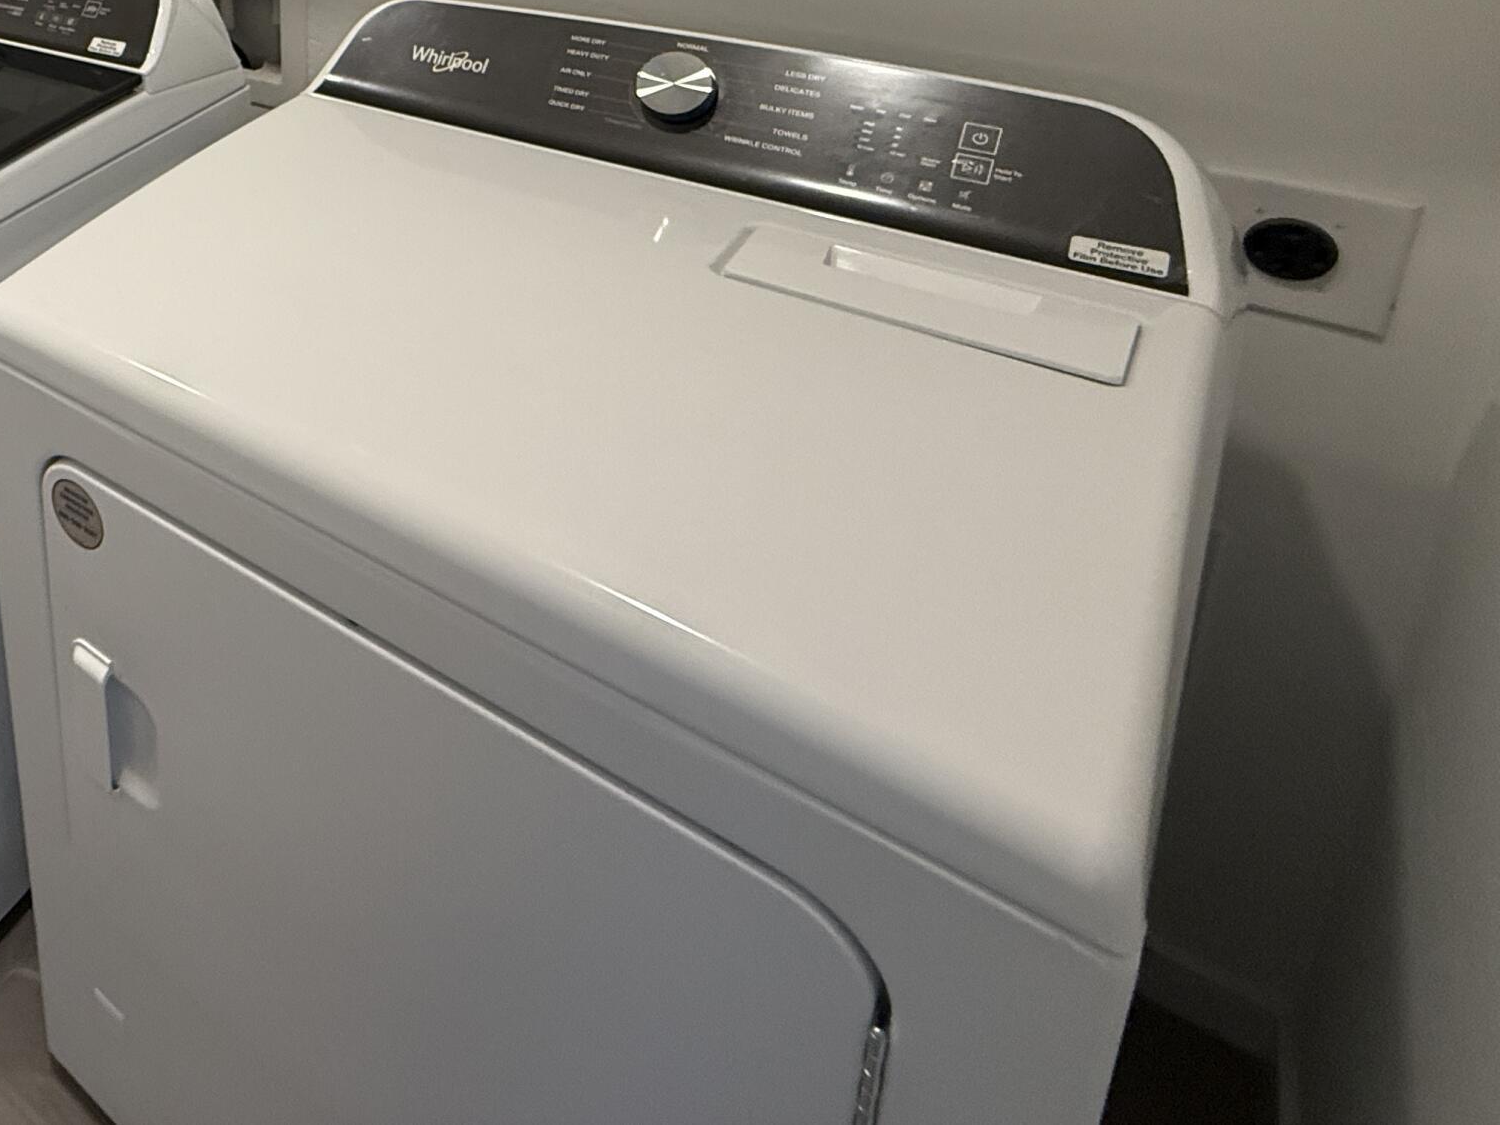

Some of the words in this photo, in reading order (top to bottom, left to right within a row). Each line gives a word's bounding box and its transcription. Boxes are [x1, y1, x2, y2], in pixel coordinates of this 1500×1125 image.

[570, 34, 589, 44] MORE
[591, 38, 607, 46] DRY
[677, 42, 709, 53] NORMAL
[412, 44, 490, 74] Whirlpool
[566, 48, 589, 59] HEAVY
[589, 52, 610, 62] DUTY
[559, 66, 572, 76] AIR
[572, 68, 592, 78] ONLY
[785, 69, 807, 80] LESS
[807, 73, 827, 83] DRY
[553, 84, 574, 95] TIMED
[574, 89, 590, 98] DRY
[773, 83, 821, 98] DELICATES
[548, 98, 570, 109] QUICK
[570, 102, 586, 112] DRY
[759, 103, 788, 115] BULKY
[788, 108, 815, 120] ITEMS
[772, 127, 809, 142] TOWELS
[724, 134, 760, 149] WRINKLE
[761, 142, 803, 157] CONTROL
[1090, 247, 1149, 265] Protective
[1097, 241, 1144, 258] Remove
[1073, 251, 1097, 262] Film
[1100, 256, 1139, 270] Before
[1141, 264, 1164, 276] Use
